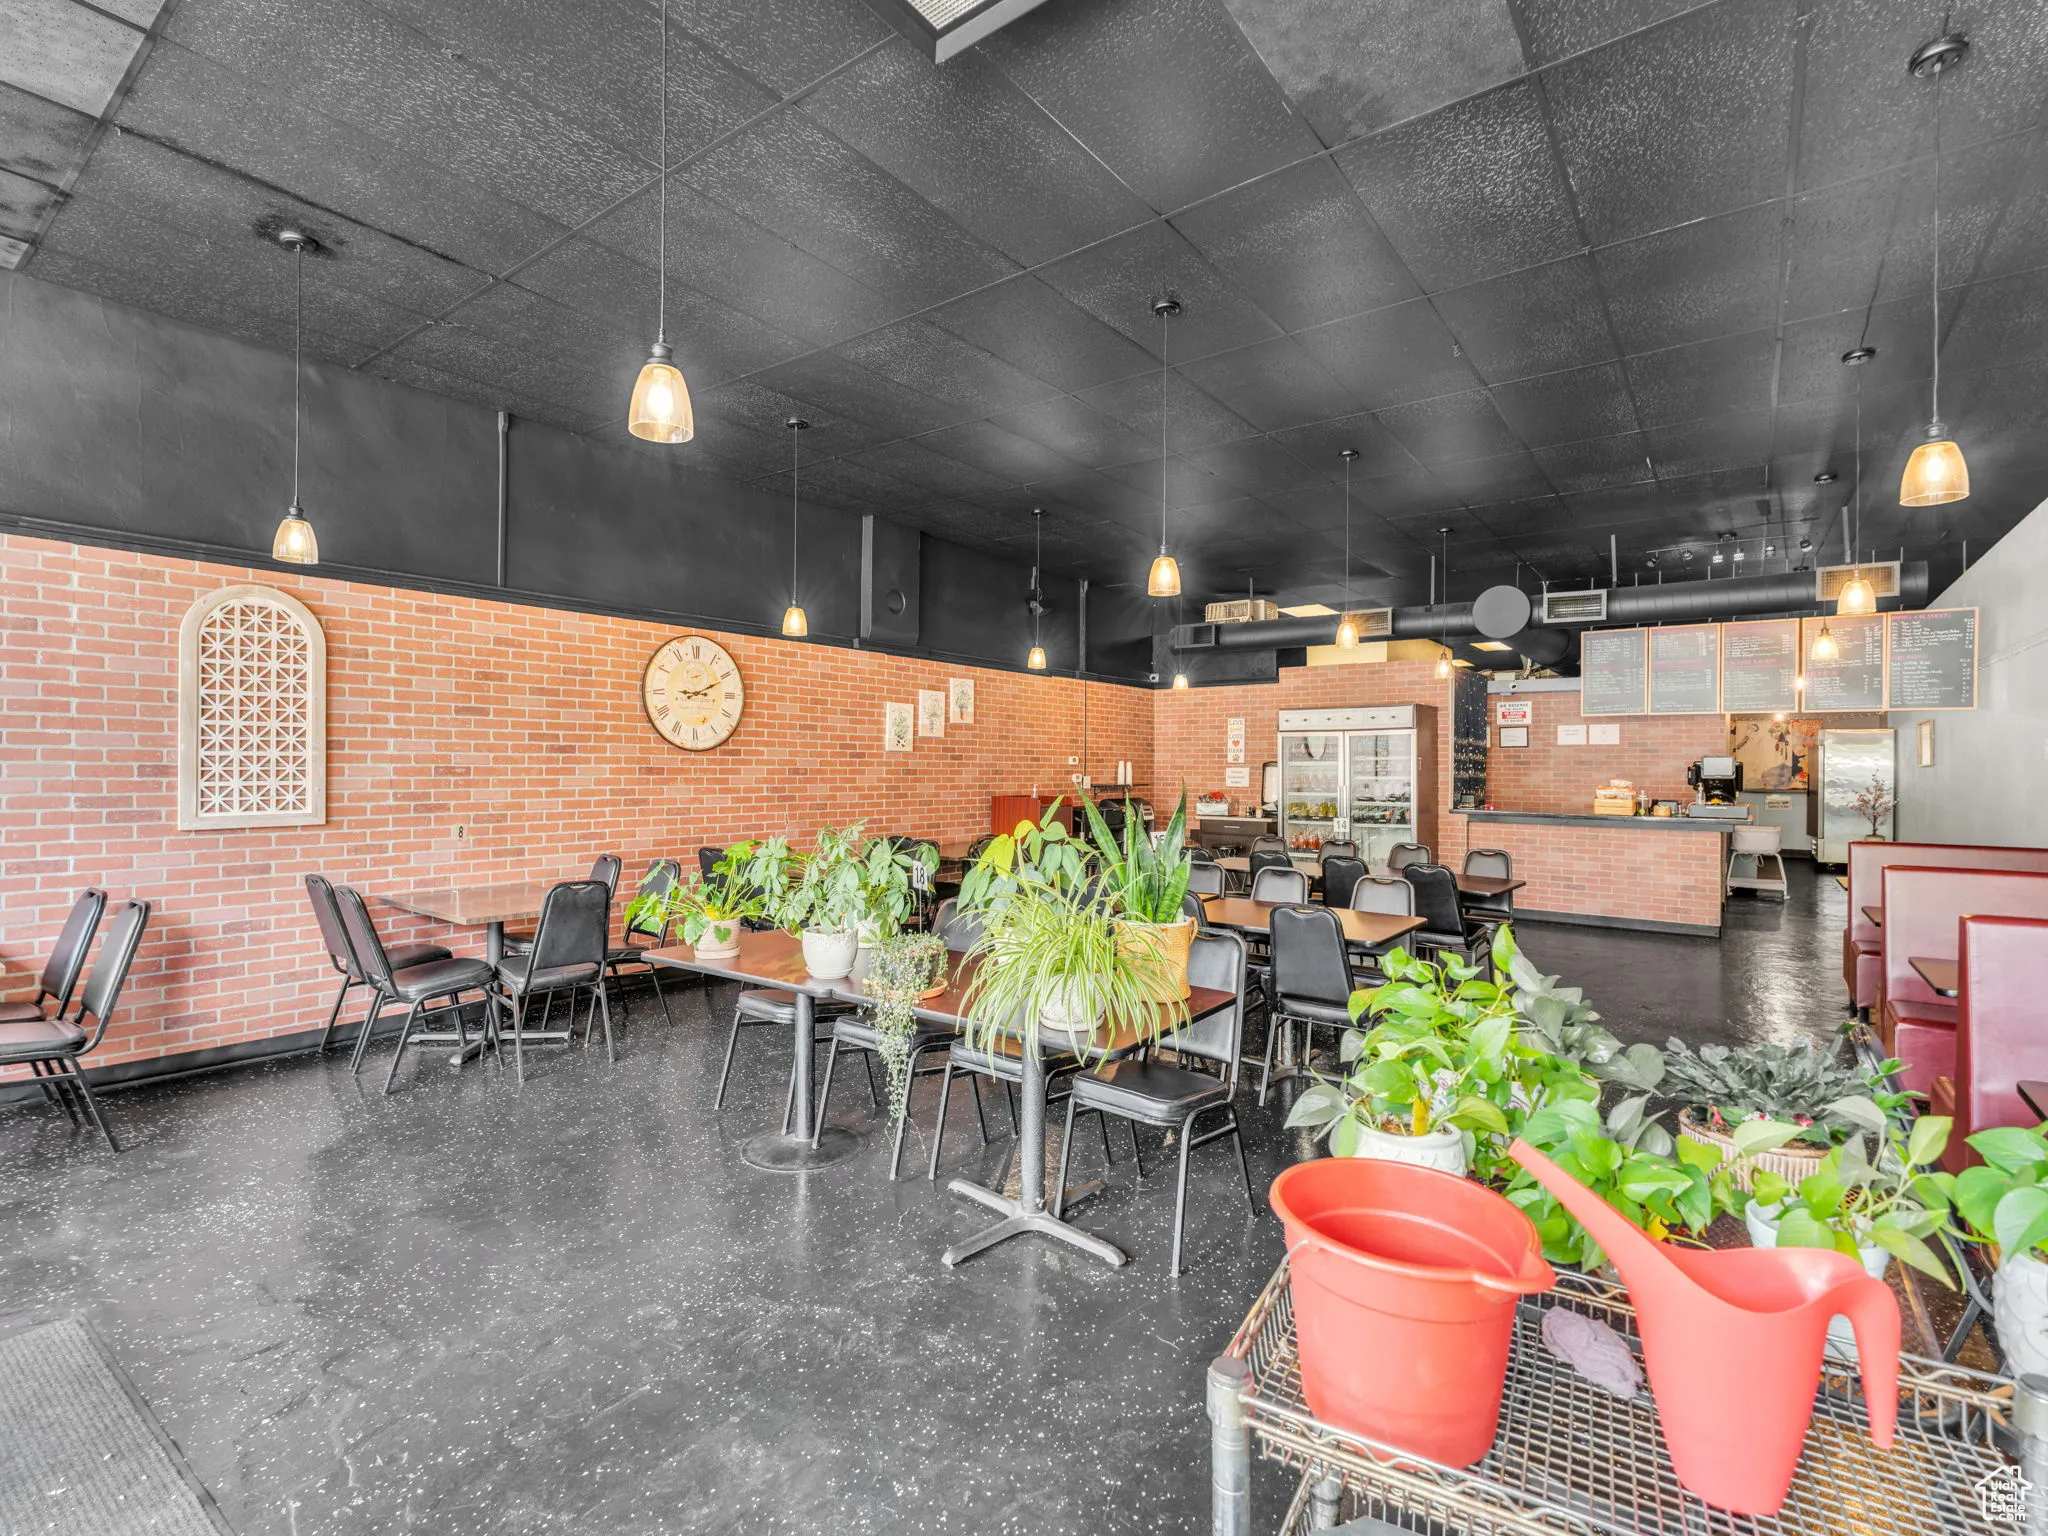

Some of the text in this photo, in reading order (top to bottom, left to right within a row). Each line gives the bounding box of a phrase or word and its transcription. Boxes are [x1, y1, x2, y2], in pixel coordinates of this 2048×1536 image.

[1337, 820, 1347, 830] 14
[458, 826, 464, 839] 8
[915, 865, 925, 885] 18
